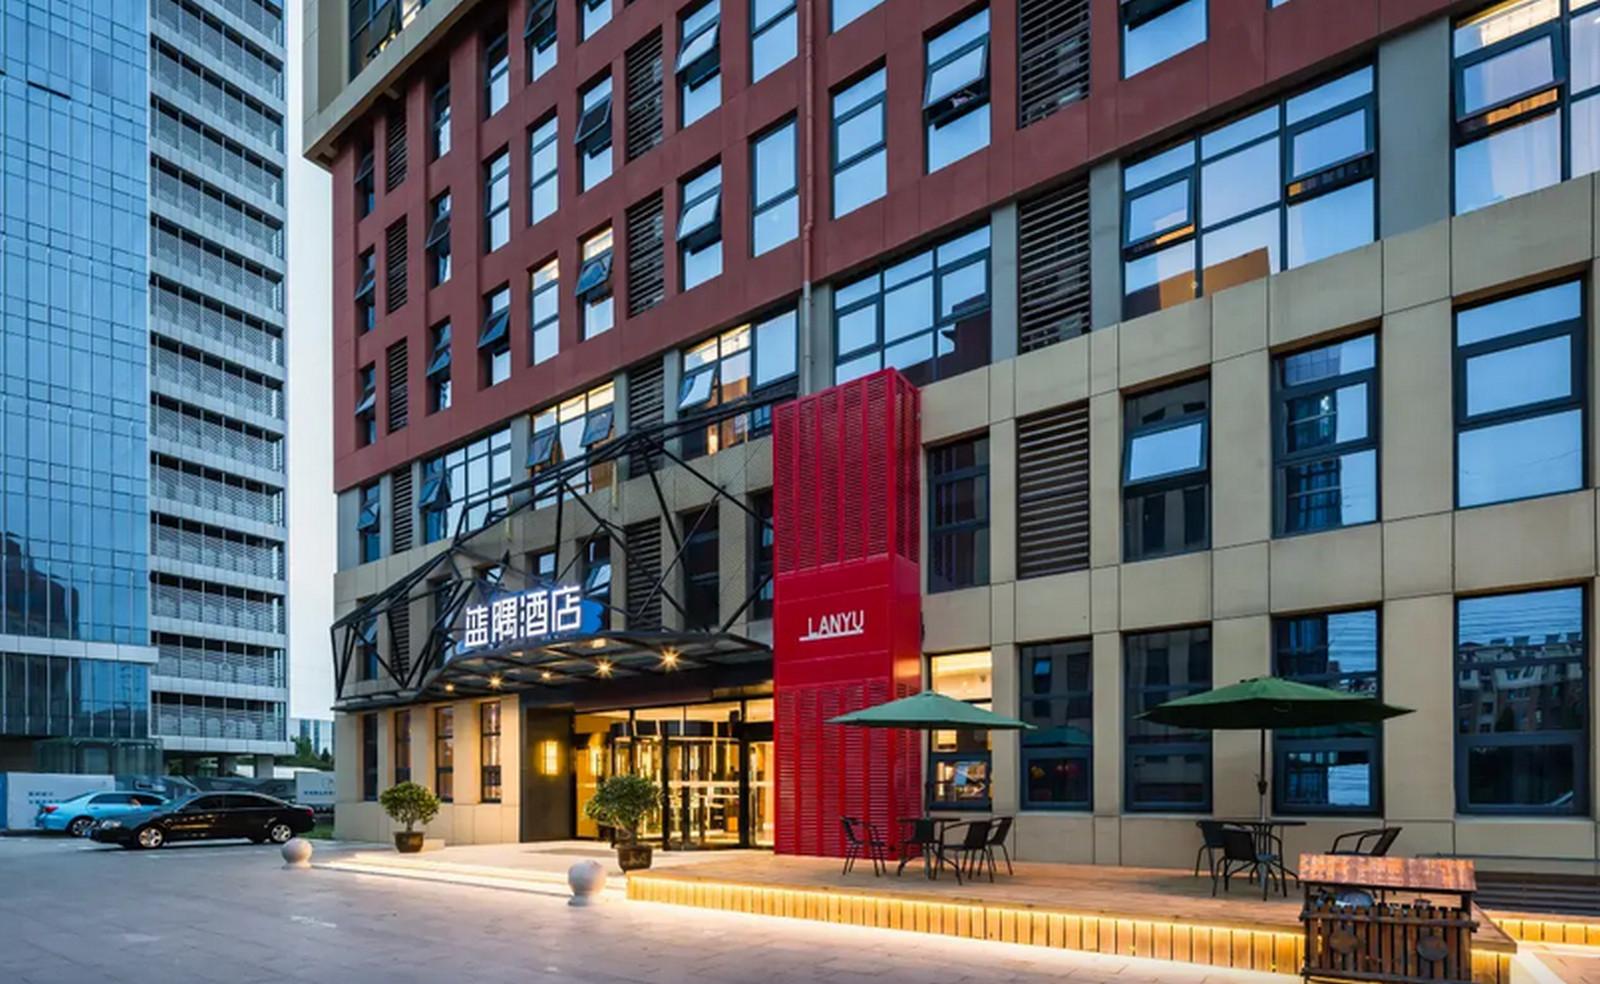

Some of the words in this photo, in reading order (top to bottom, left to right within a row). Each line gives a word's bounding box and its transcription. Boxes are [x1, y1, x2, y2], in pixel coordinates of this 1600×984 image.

[464, 585, 582, 648] 蓝隅酒店
[800, 609, 864, 641] LANYU
